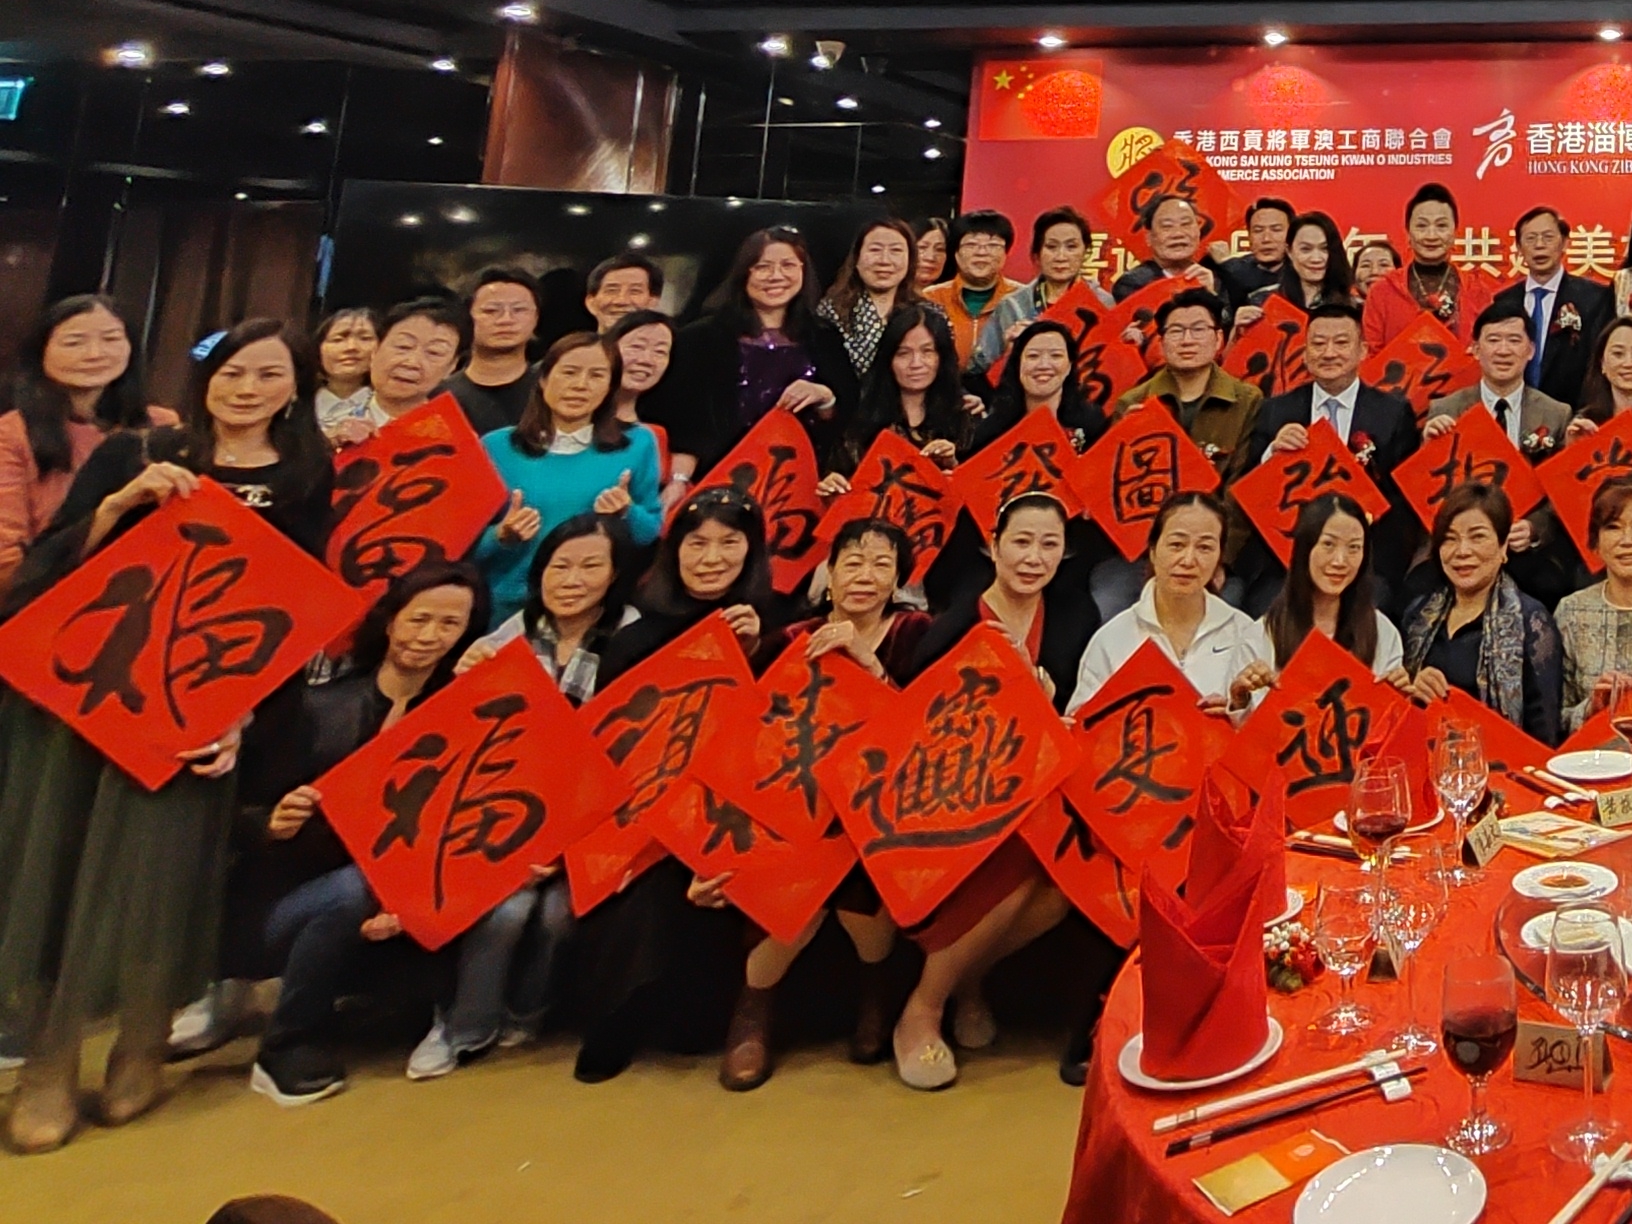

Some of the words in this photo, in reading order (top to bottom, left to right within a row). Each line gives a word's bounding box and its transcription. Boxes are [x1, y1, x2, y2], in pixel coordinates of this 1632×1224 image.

[1173, 127, 1453, 152] 香港西貢將軍澳工商聯合會
[1240, 155, 1259, 167] SAI
[1261, 155, 1293, 167] KUNG
[1294, 154, 1339, 166] TSEUNG
[1341, 154, 1375, 166] KWAN
[1376, 154, 1387, 165] O
[1388, 153, 1453, 166] INDUSTRIES
[1528, 159, 1568, 174] HONG
[1569, 159, 1609, 174] KONG
[1216, 169, 1260, 181] MERCE
[1261, 168, 1335, 181] ASSOCIATION
[1112, 432, 1180, 524] 圖
[52, 522, 295, 730] 福
[371, 693, 546, 912] 福
